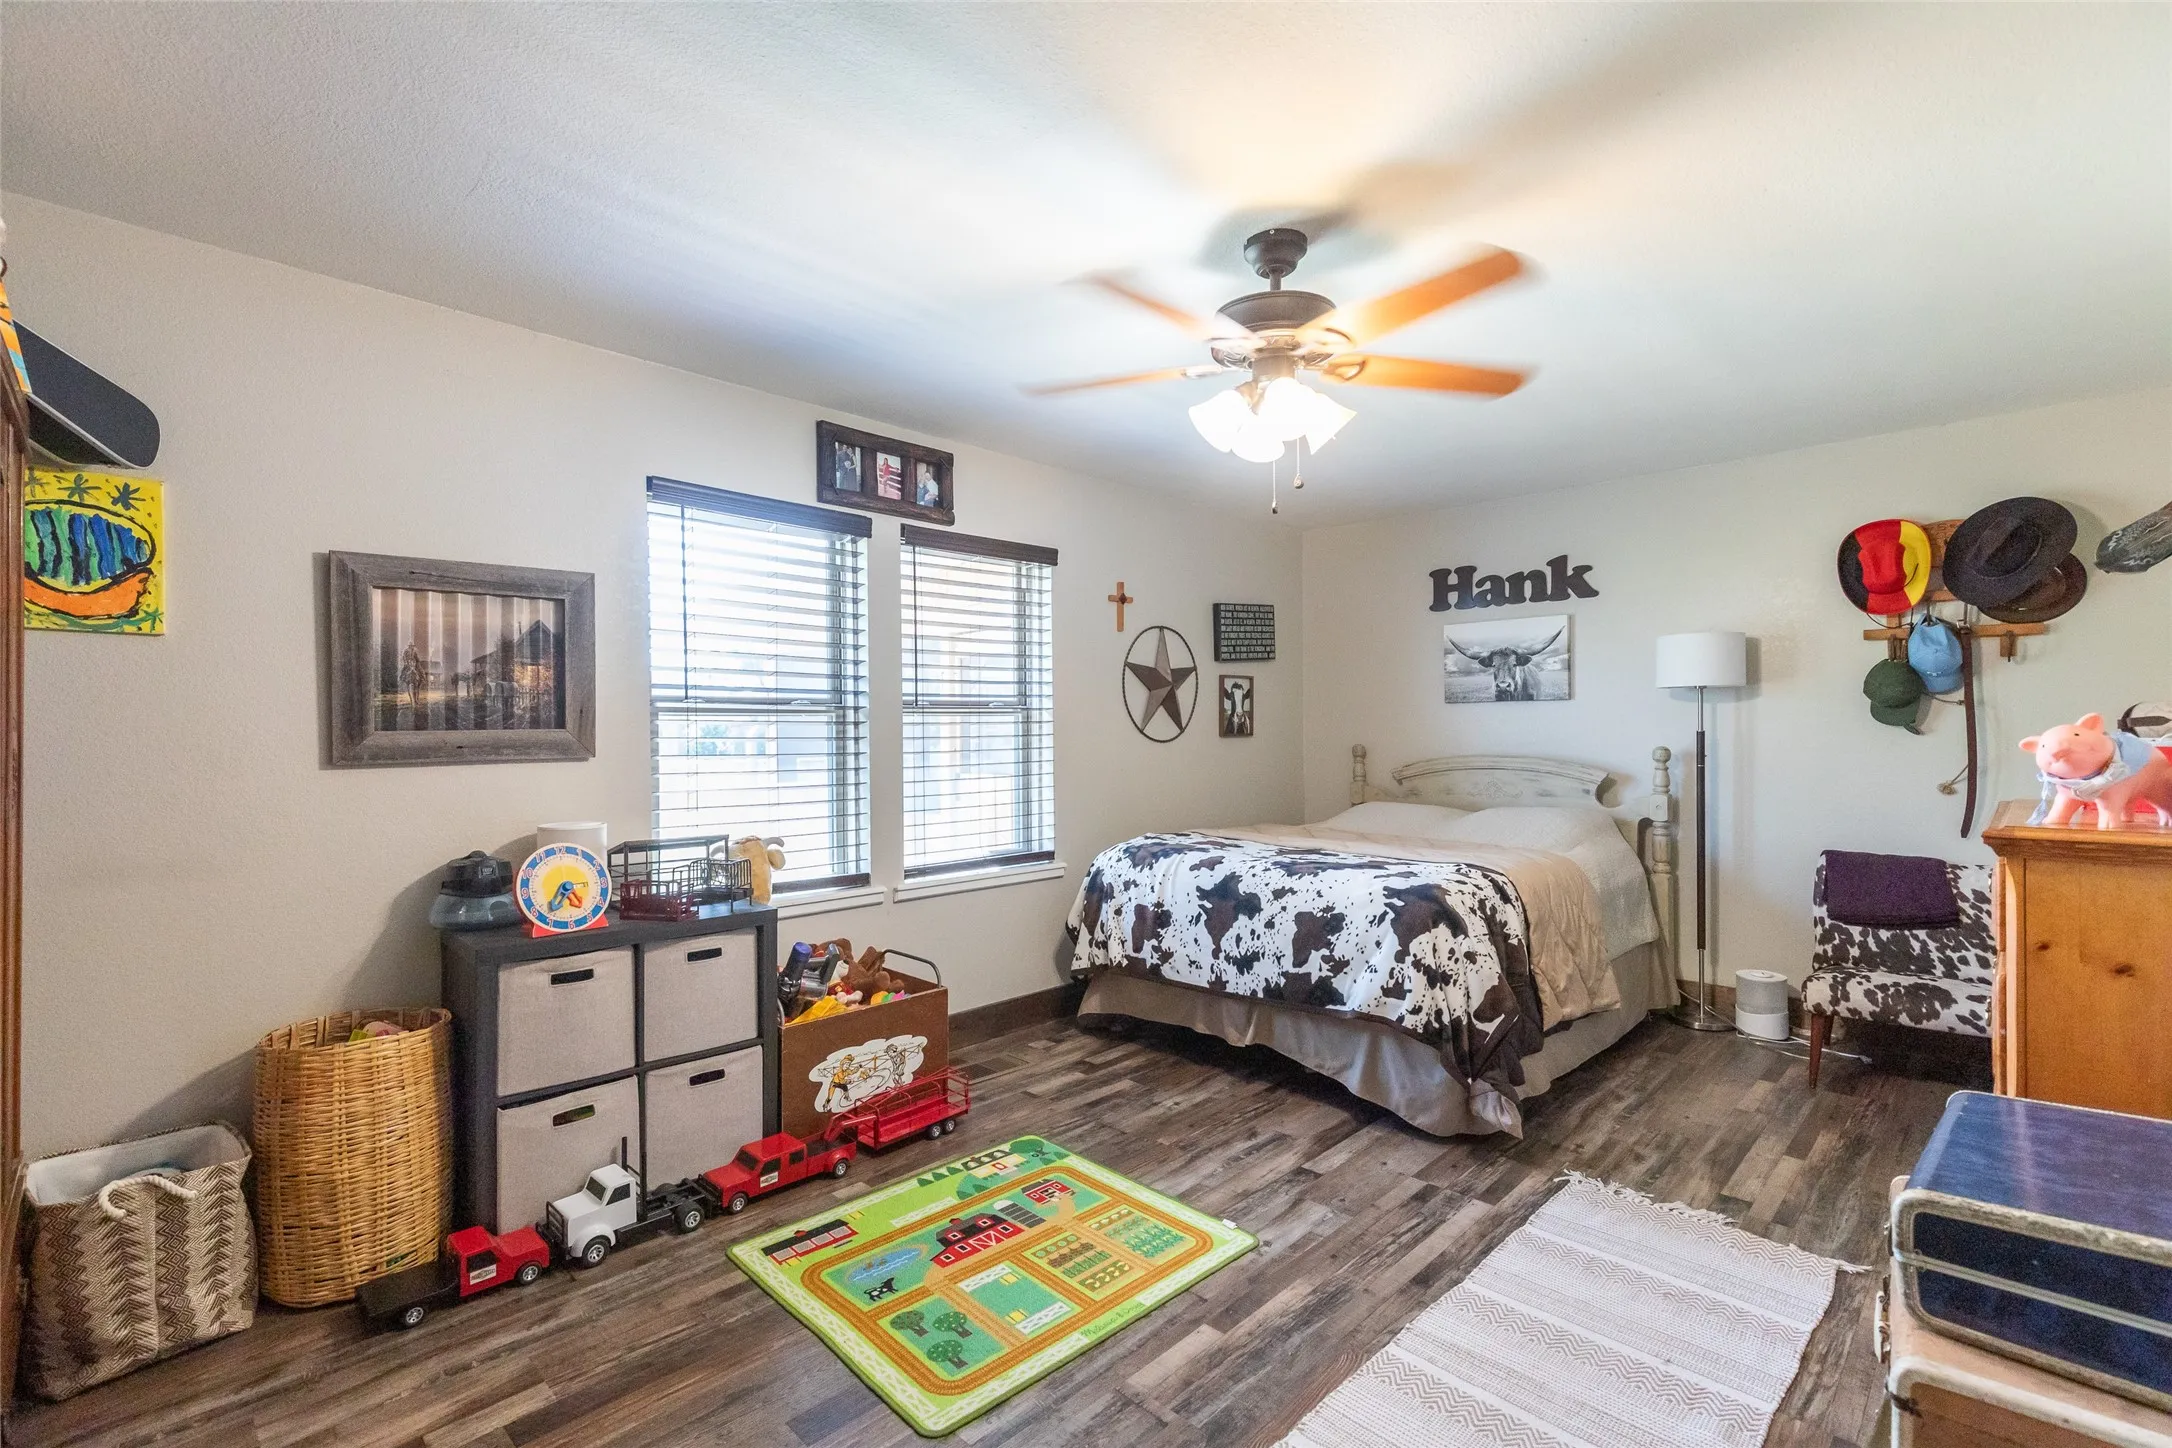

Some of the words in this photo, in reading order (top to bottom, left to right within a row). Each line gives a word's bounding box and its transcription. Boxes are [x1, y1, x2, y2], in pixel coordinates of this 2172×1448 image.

[1429, 554, 1600, 612] Hank
[554, 846, 567, 855] 12
[535, 852, 546, 863] 11
[521, 867, 534, 879] 10
[600, 877, 608, 888] 3
[521, 888, 529, 899] 9
[598, 897, 605, 907] 4
[530, 907, 538, 917] 8
[547, 918, 554, 928] 7
[568, 920, 576, 930] 6
